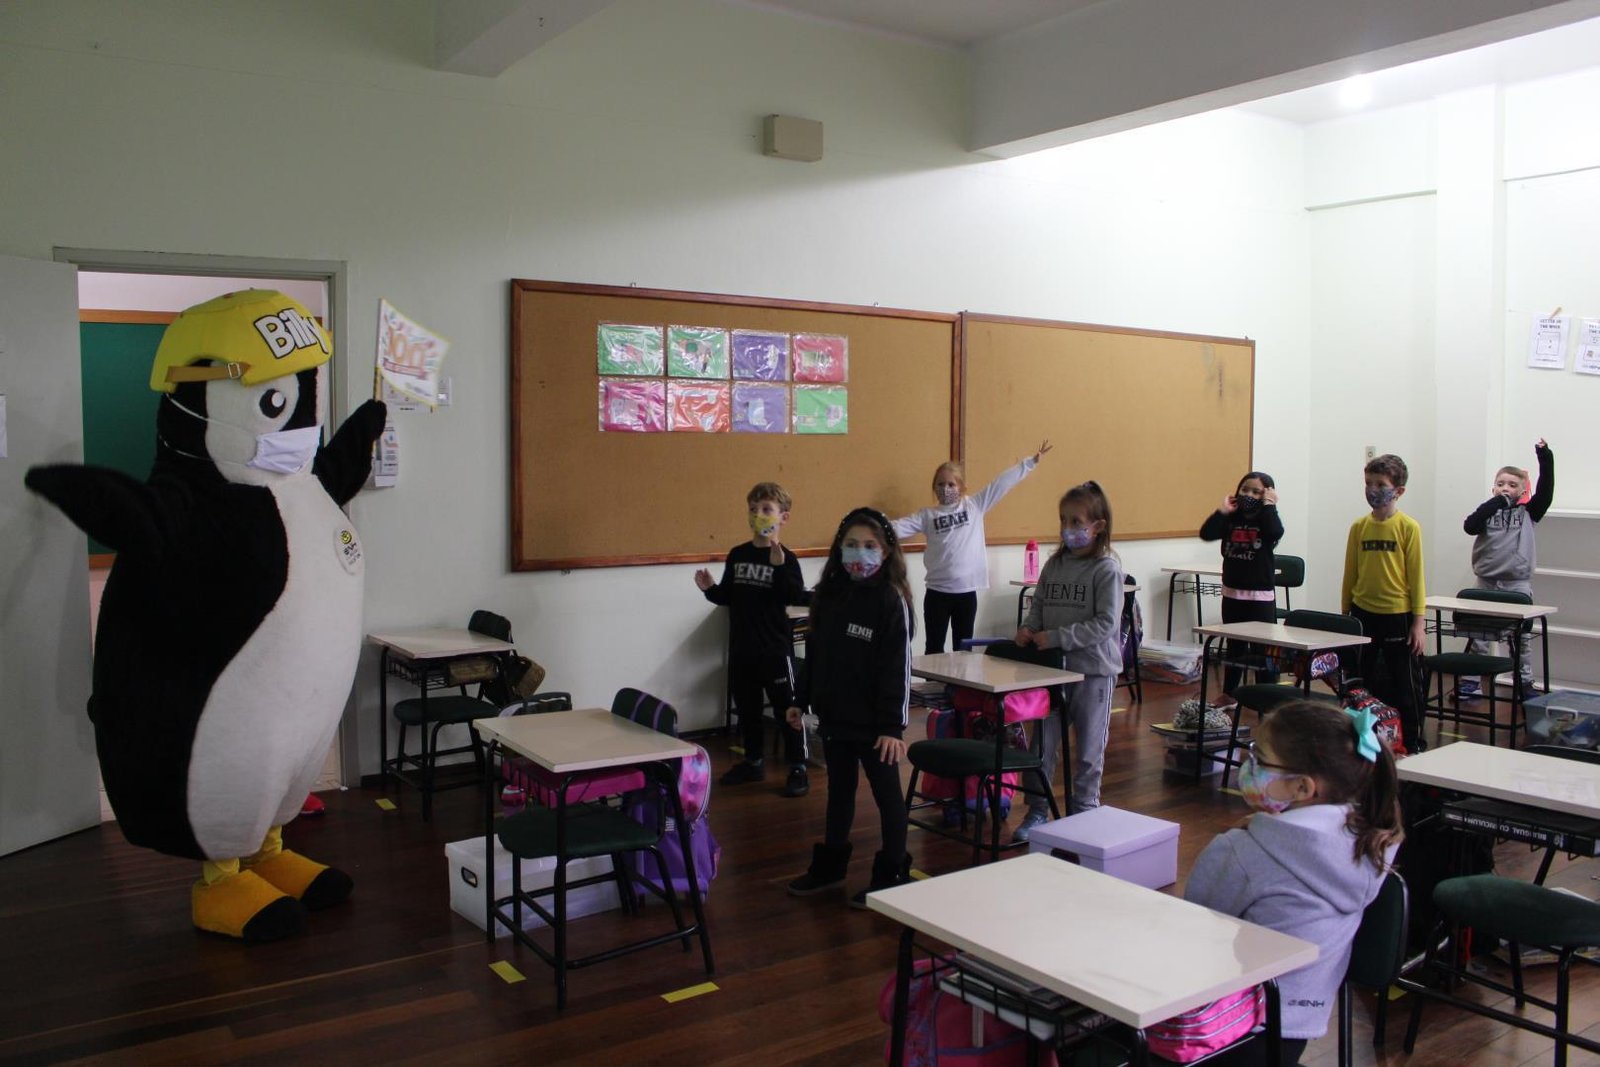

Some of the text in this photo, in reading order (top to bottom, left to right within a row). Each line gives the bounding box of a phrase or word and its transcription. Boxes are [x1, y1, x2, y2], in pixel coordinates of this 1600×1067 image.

[253, 307, 329, 359] Billy
[933, 510, 969, 531] IENH
[1361, 540, 1396, 552] IENH
[1044, 583, 1088, 602] IENH
[847, 623, 873, 639] IENH
